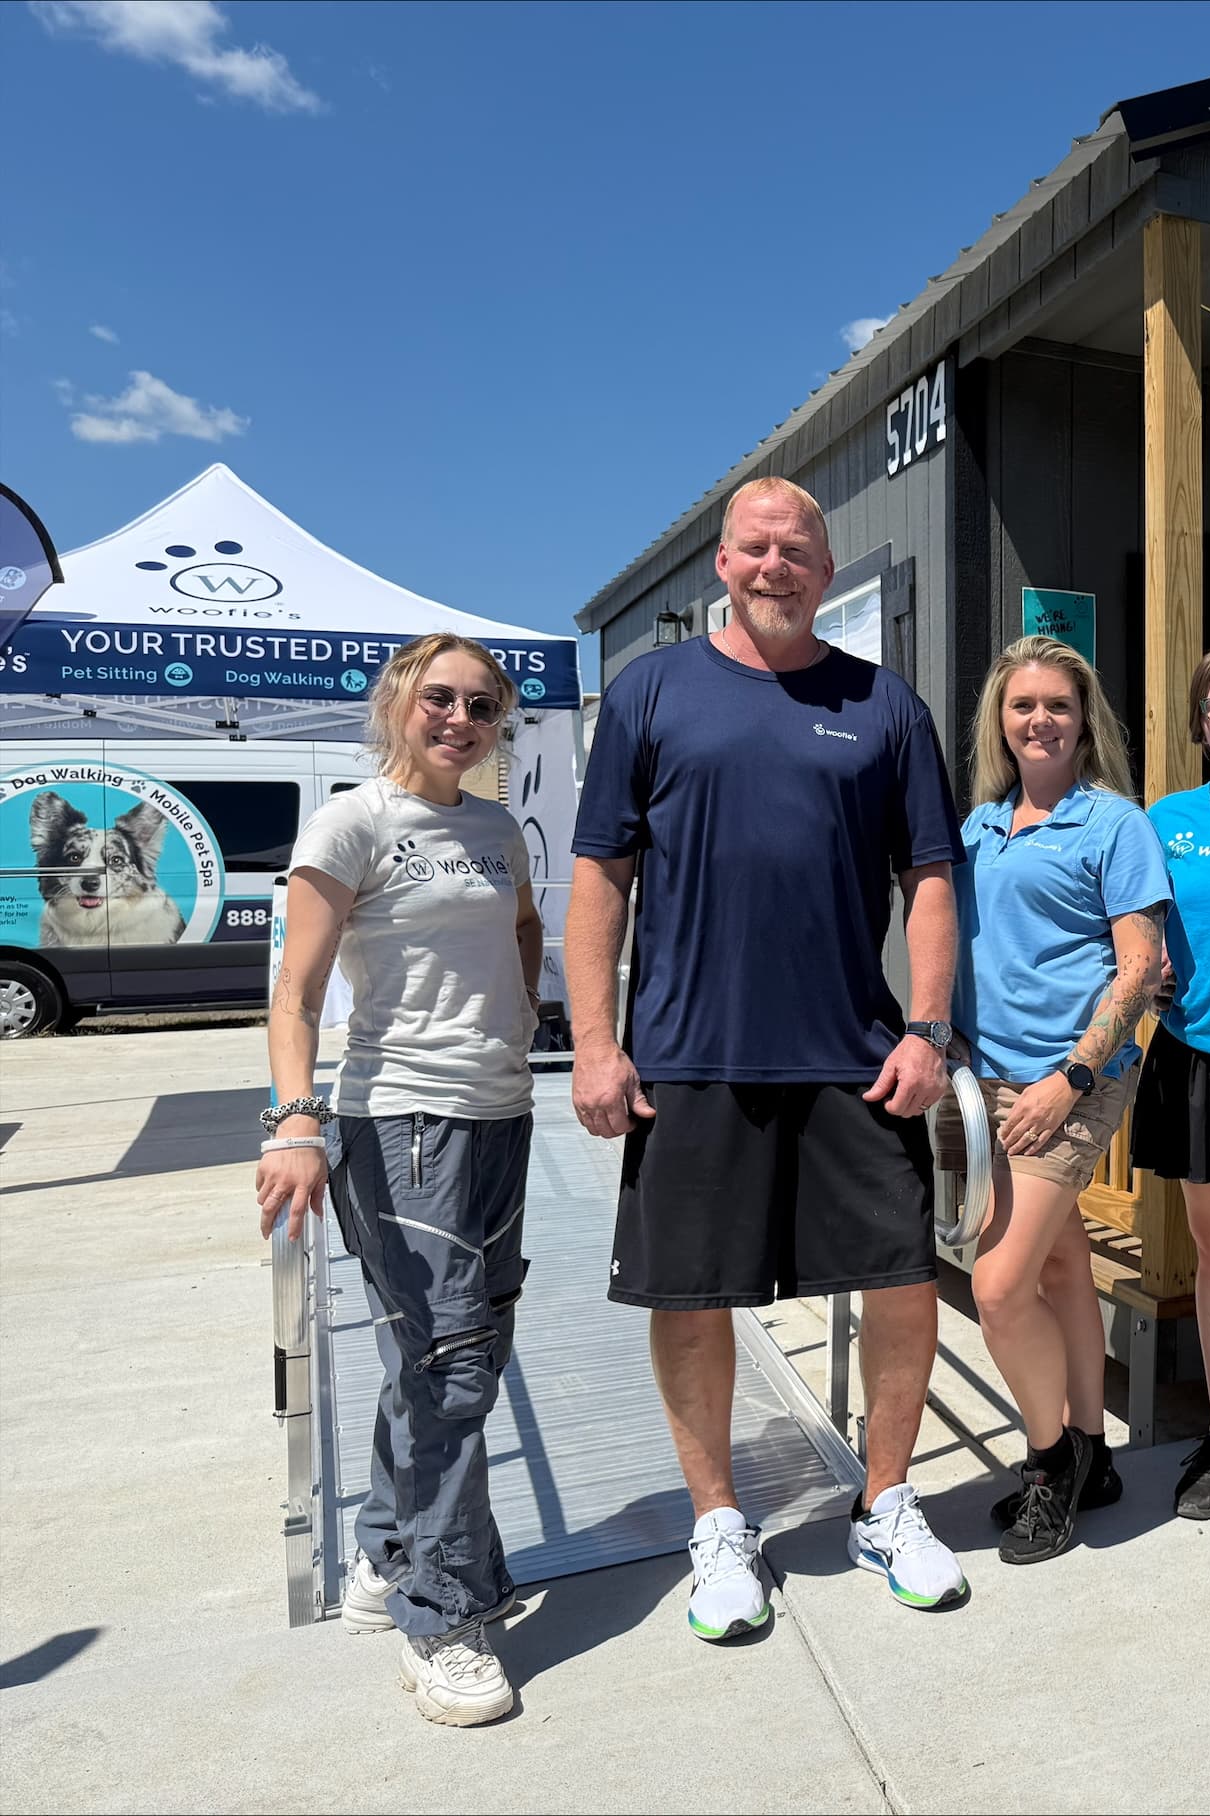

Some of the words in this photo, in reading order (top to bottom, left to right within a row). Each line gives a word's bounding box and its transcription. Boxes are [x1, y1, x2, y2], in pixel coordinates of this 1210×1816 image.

[886, 359, 946, 476] 5704
[149, 606, 301, 620] woofie's
[61, 629, 164, 656] YOUR
[171, 632, 333, 663] TRUSTED
[341, 641, 402, 664] PET
[61, 666, 93, 680] Pet
[97, 666, 157, 684] Sitting
[226, 670, 260, 687] Dog
[264, 671, 334, 690] Walking
[11, 772, 48, 791] Dog
[51, 768, 124, 787] Walking
[150, 789, 194, 832] Mobile
[190, 832, 210, 857] Pet
[199, 860, 214, 888] Spa
[437, 854, 509, 875] woofie'
